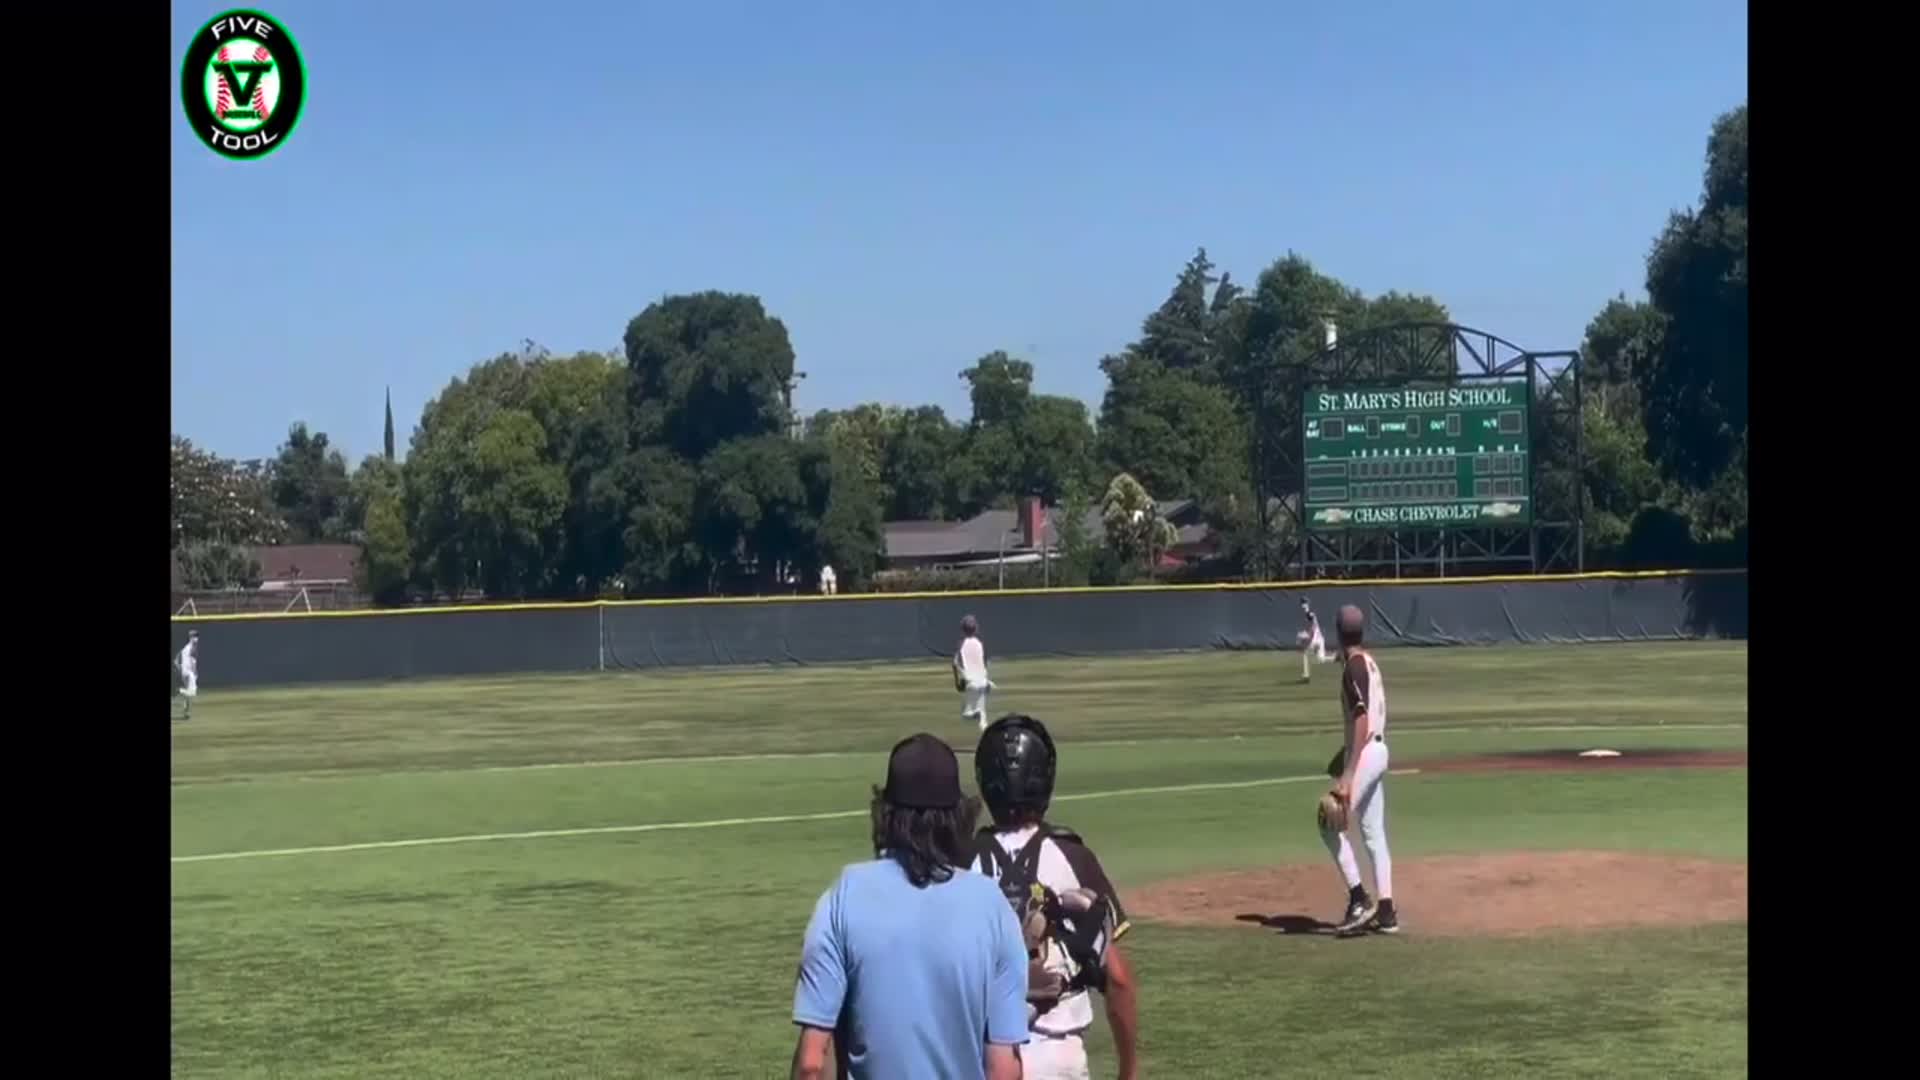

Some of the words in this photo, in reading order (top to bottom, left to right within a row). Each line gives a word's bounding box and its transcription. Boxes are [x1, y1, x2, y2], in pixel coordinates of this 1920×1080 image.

[1319, 393, 1340, 411] ST.
[1344, 392, 1401, 410] MARY'S
[1405, 389, 1446, 408] HIGH
[1448, 388, 1512, 407] SCHOOL
[1347, 424, 1366, 433] BALL
[1380, 422, 1407, 432] STRIKE
[1430, 420, 1446, 430] OUT
[1354, 507, 1398, 524] CHASE
[1399, 504, 1479, 521] CHEVROLET
